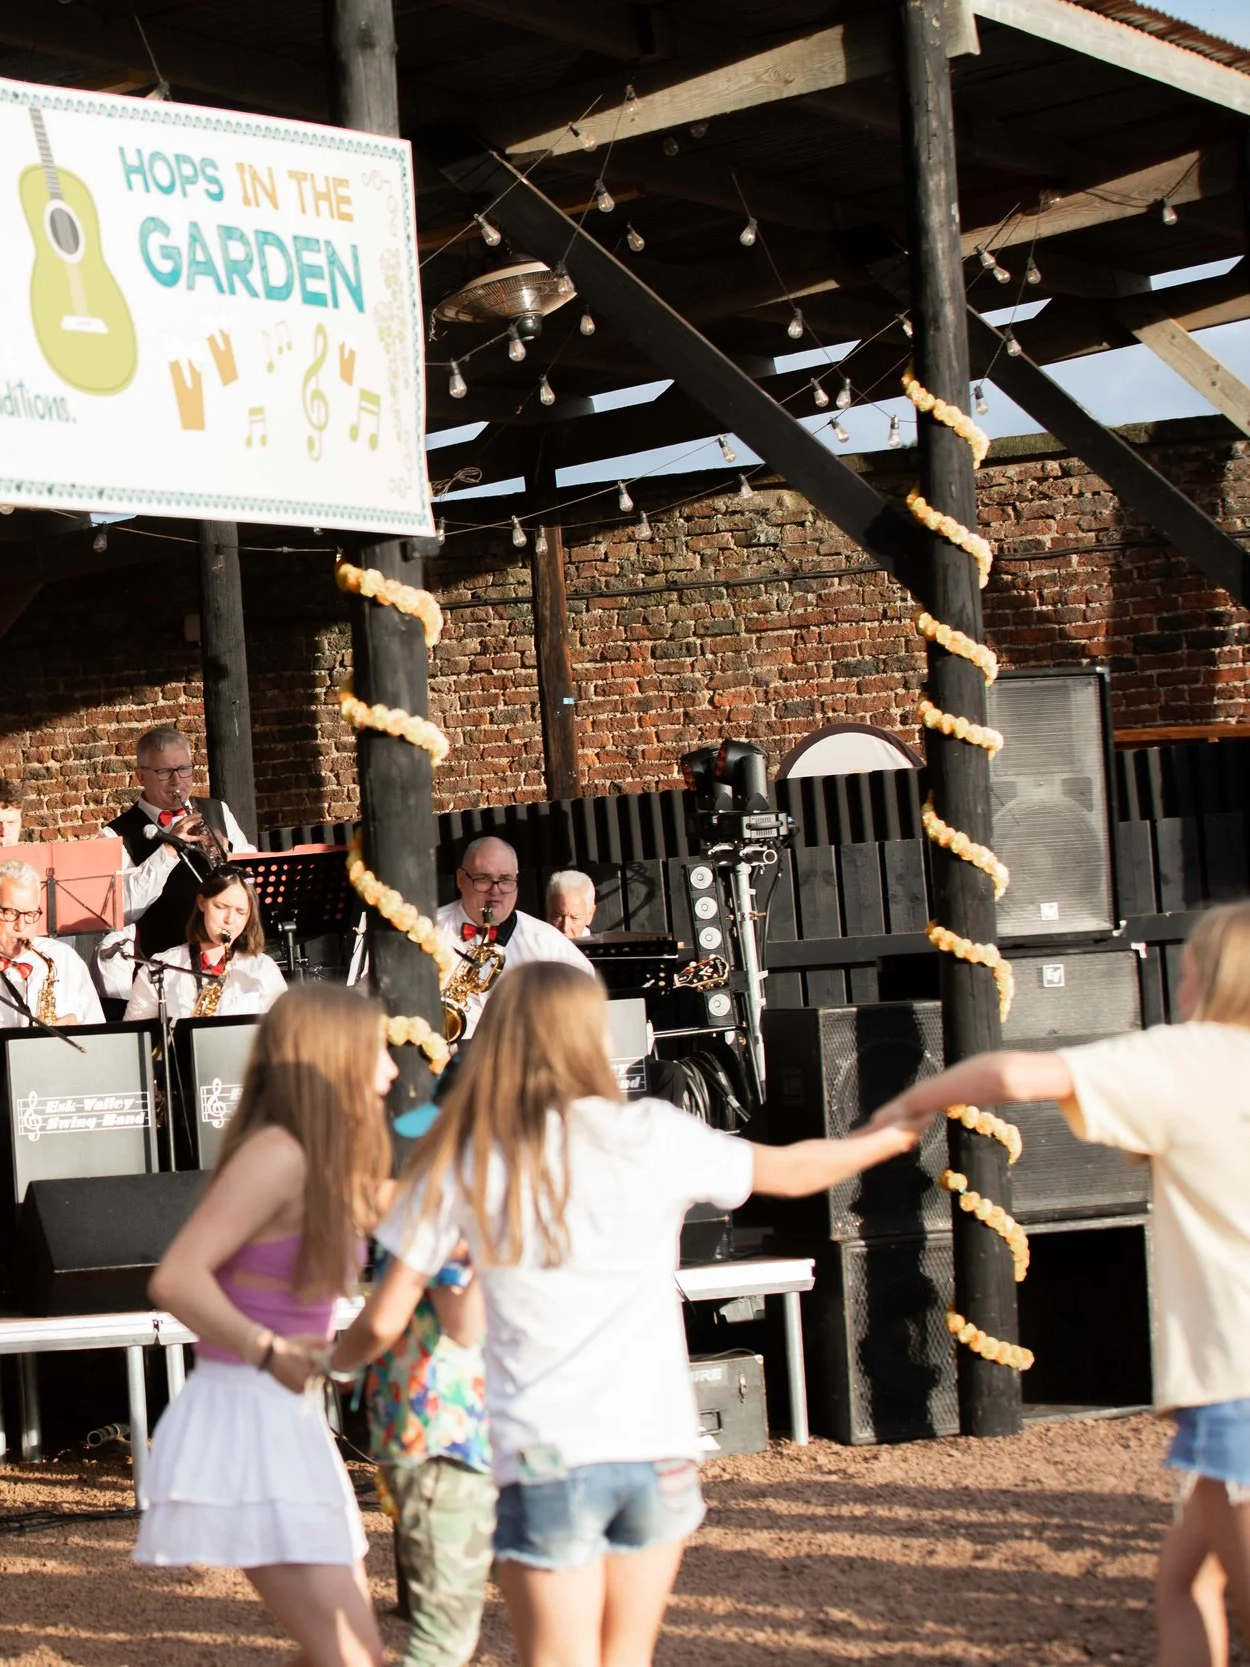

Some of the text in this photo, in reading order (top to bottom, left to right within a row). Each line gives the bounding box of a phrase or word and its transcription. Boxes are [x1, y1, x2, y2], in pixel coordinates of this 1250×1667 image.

[119, 146, 354, 222] HOPS IN THE
[139, 216, 365, 313] GARDEN
[45, 1111, 146, 1130] Swing Band
[82, 1096, 136, 1112] Valley
